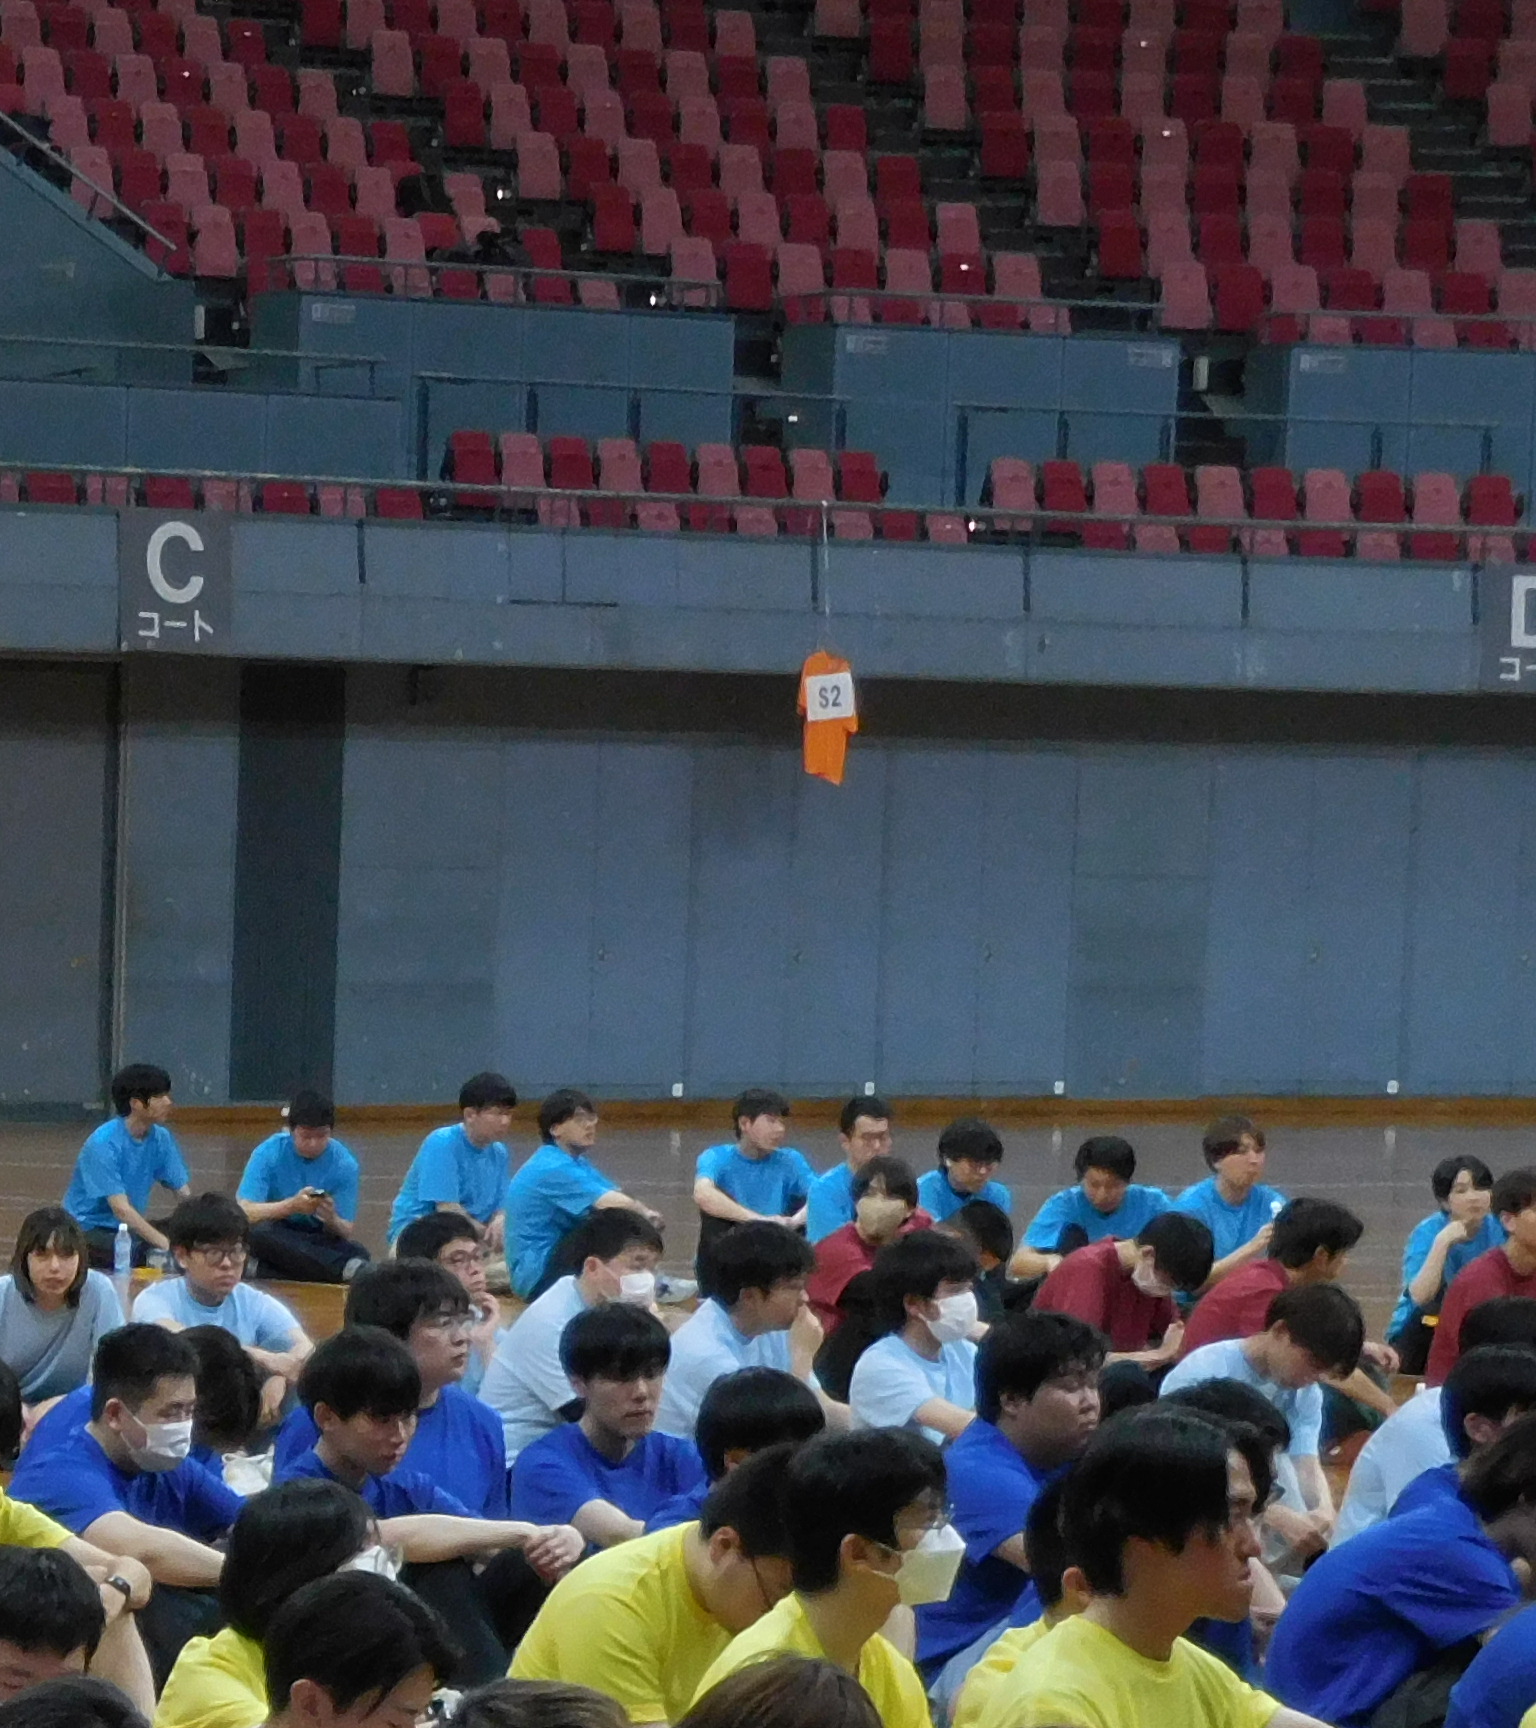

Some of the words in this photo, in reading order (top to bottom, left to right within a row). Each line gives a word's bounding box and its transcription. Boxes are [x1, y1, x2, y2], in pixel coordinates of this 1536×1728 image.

[147, 520, 205, 604] C
[138, 610, 214, 643] コート
[818, 684, 843, 709] S2
